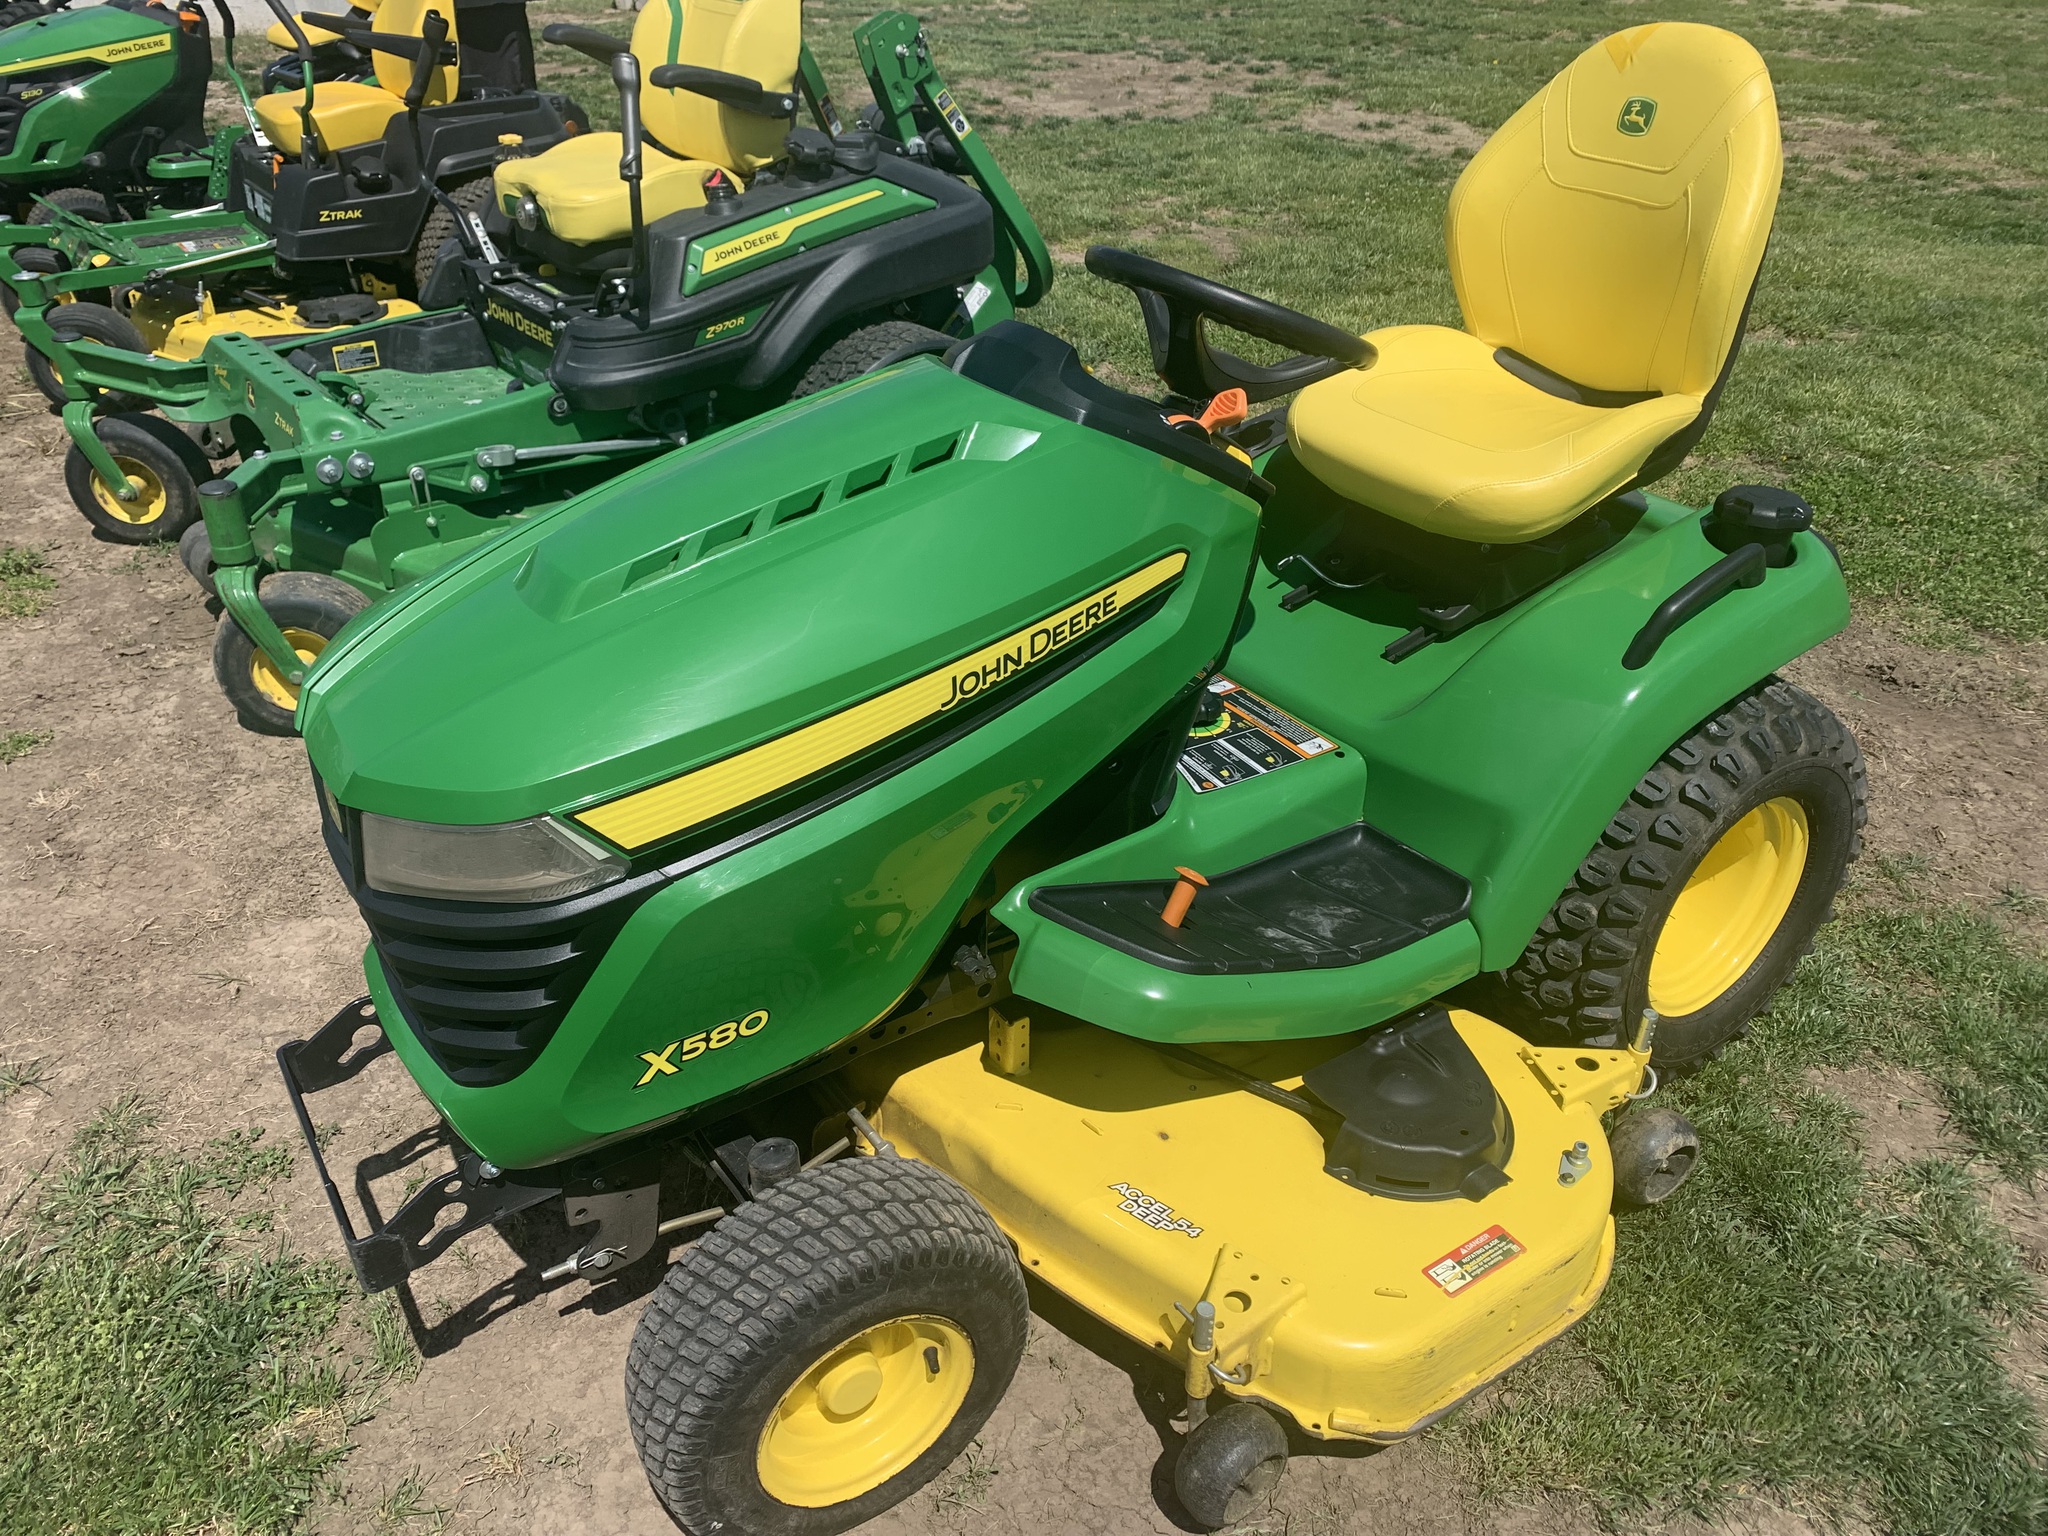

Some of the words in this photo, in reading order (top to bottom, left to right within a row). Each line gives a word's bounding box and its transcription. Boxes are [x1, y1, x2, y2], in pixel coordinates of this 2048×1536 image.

[106, 48, 132, 57] JOHN
[134, 39, 166, 52] DEERE
[319, 209, 362, 222] ZTRAK
[714, 247, 743, 262] JOHN
[744, 231, 780, 249] DEERE
[487, 298, 515, 327] JOHN
[515, 311, 554, 348] DEERE
[705, 317, 746, 339] Z970R
[274, 412, 294, 437] ZTRAK
[940, 645, 1024, 711] JOHN
[1030, 590, 1118, 662] DEERE
[632, 1008, 771, 1088] X580
[1107, 1182, 1175, 1222] ACCEL
[1174, 1217, 1204, 1238] 54
[1117, 1199, 1174, 1231] DEEP
[1461, 1248, 1485, 1264] ROTATING
[1464, 1233, 1490, 1251] DANGER
